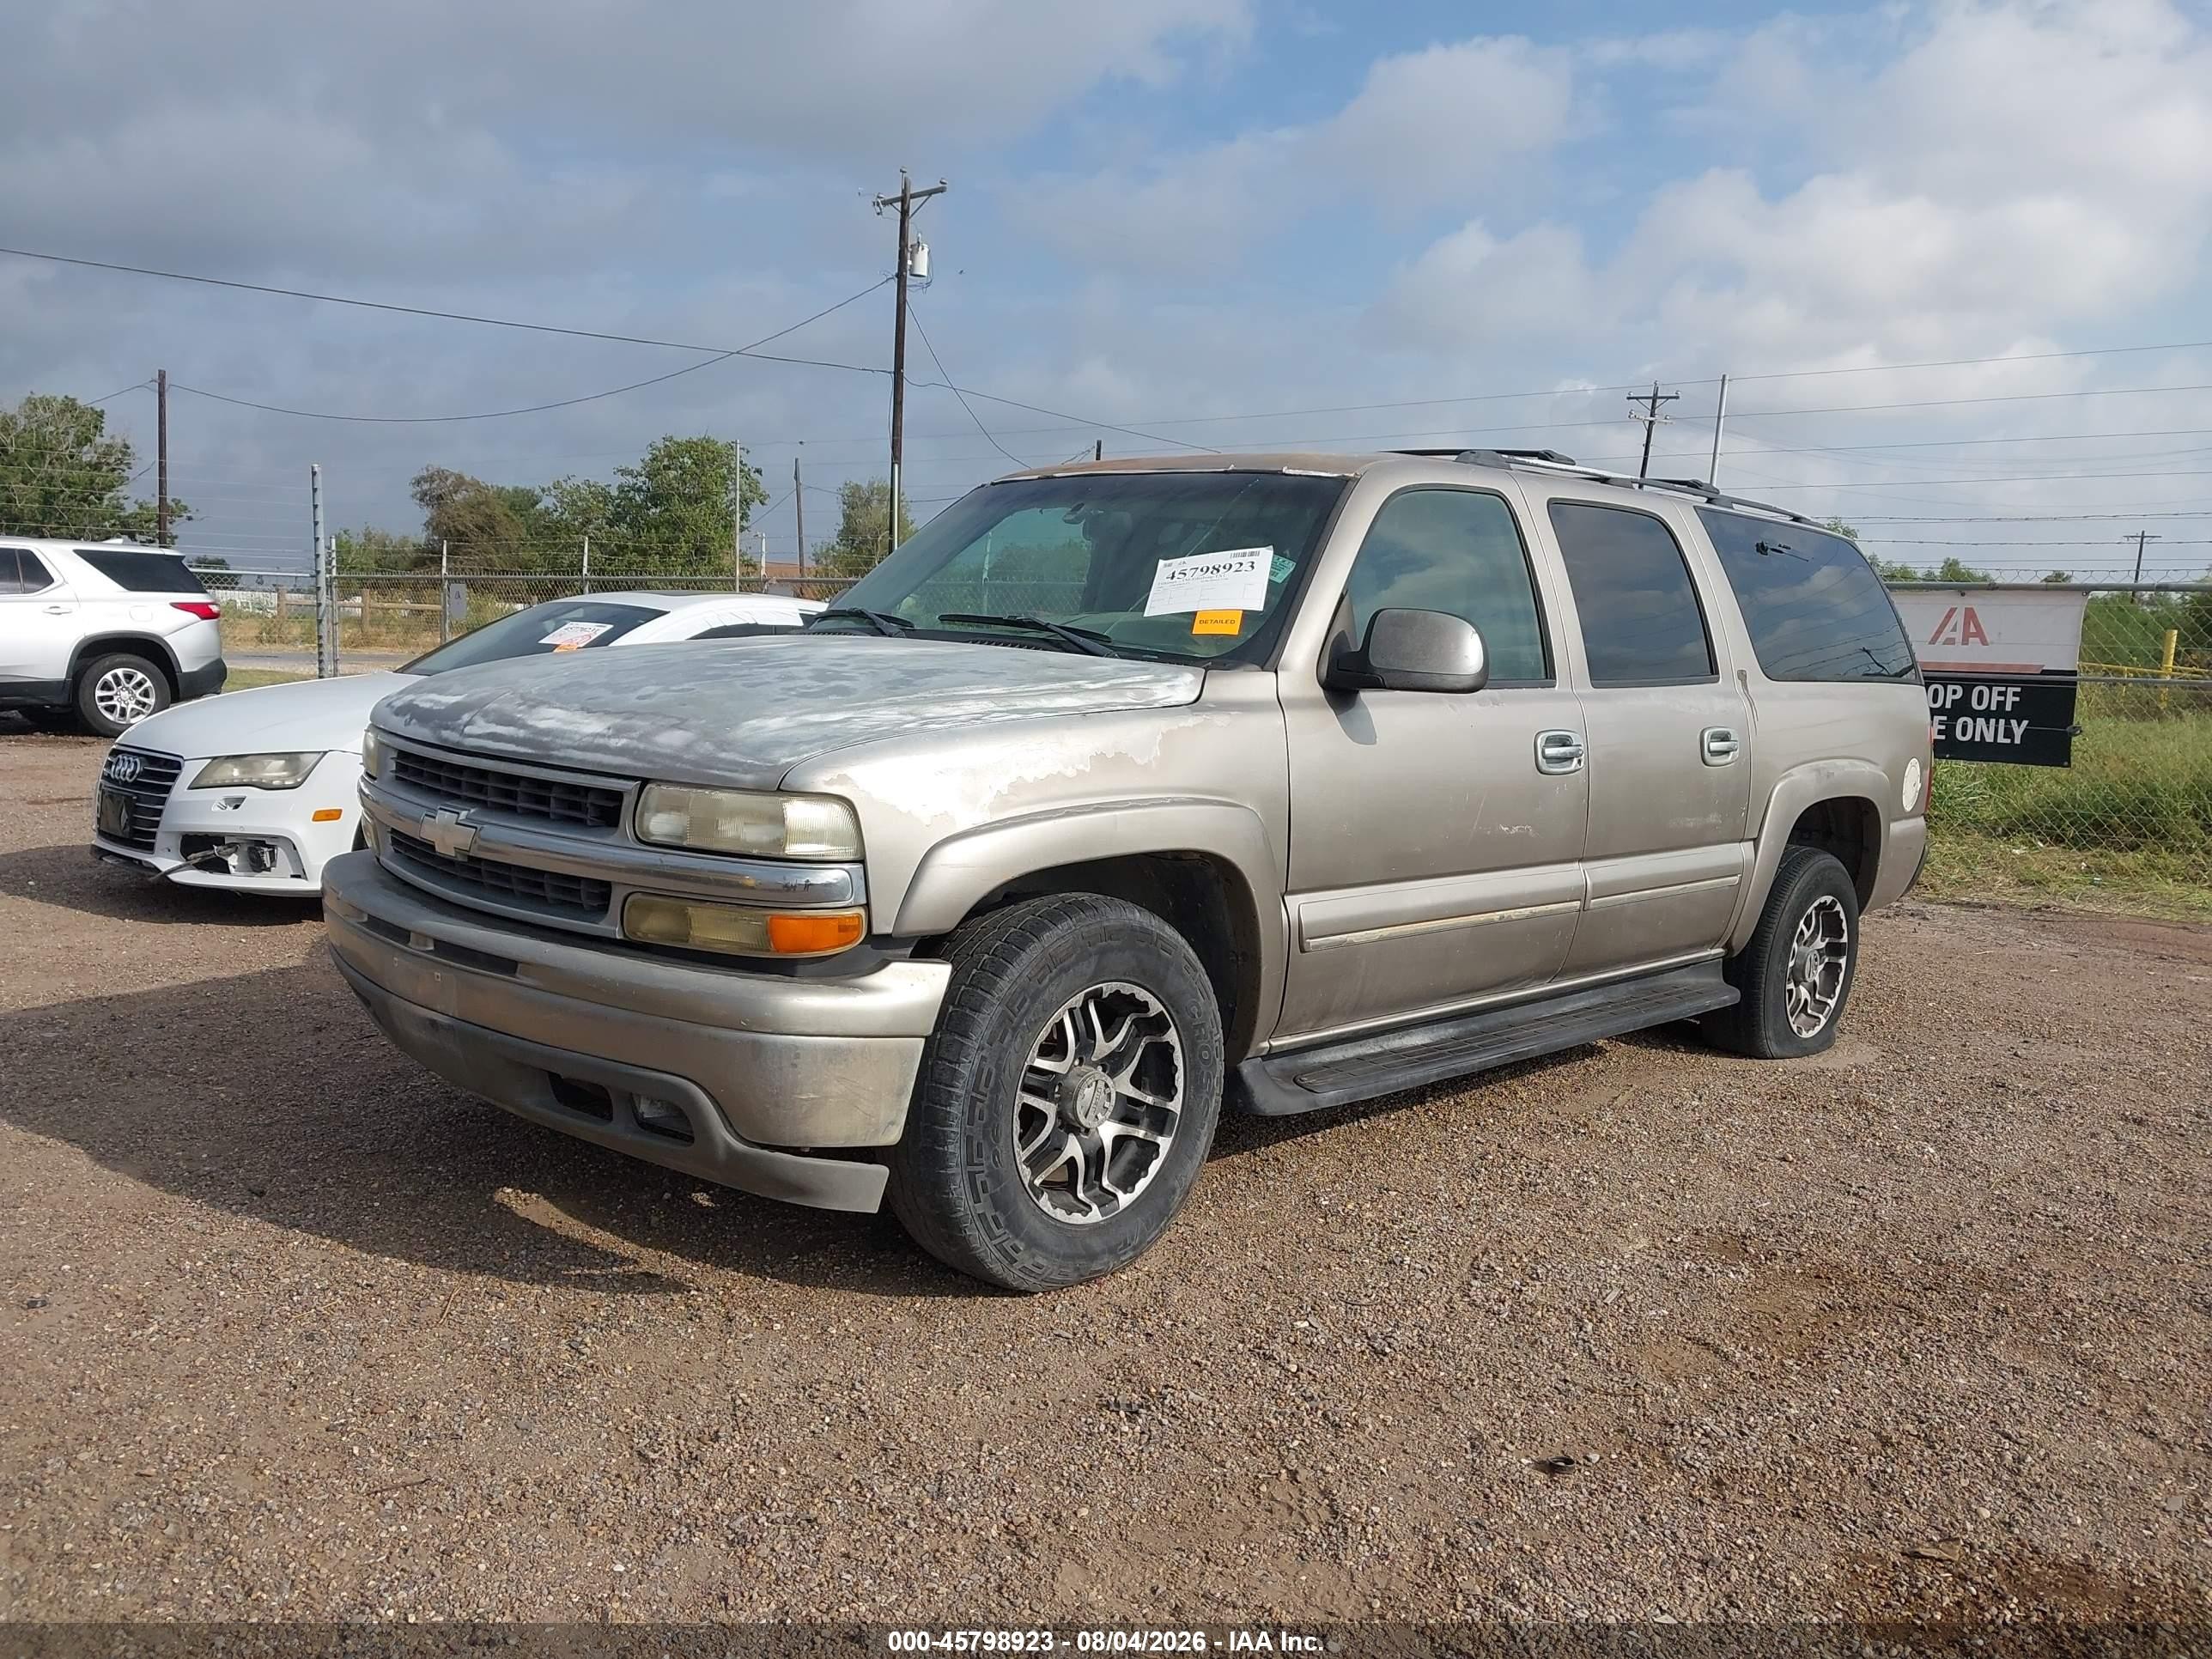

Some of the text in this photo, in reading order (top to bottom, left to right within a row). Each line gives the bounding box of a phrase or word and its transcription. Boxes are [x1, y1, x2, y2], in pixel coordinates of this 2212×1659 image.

[1165, 561, 1255, 580] 45798923
[1928, 684, 2021, 711] OP OFF
[1955, 716, 2029, 744] ONLY
